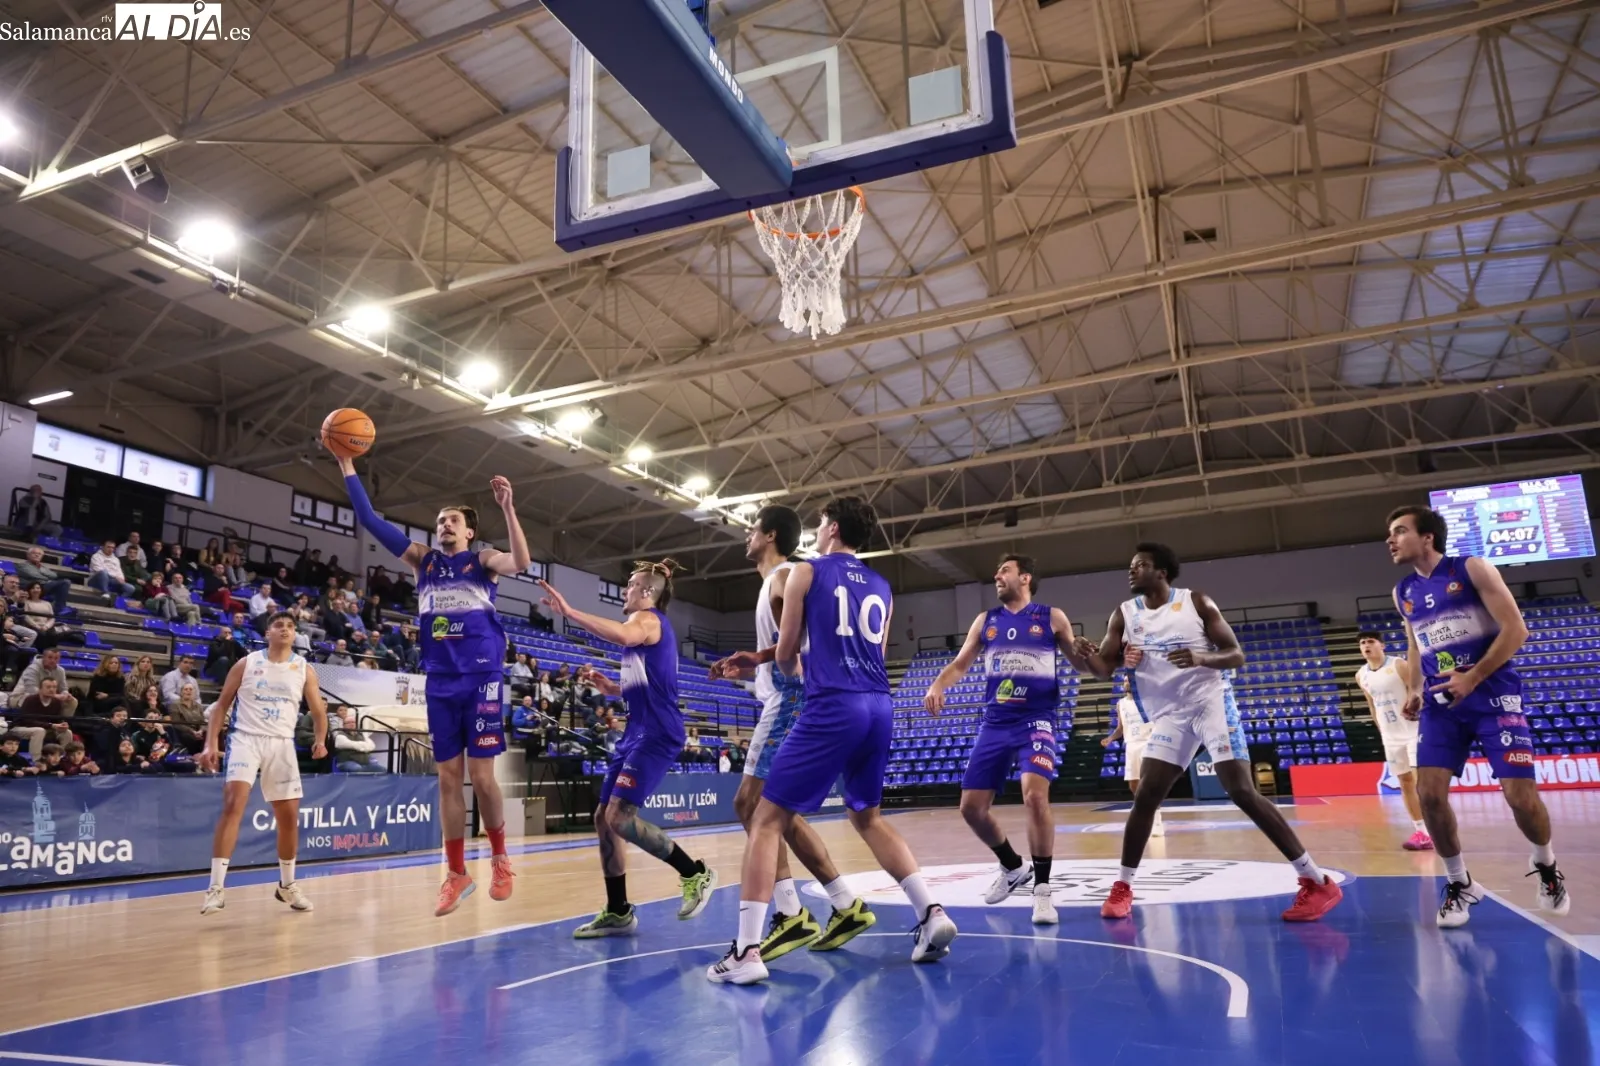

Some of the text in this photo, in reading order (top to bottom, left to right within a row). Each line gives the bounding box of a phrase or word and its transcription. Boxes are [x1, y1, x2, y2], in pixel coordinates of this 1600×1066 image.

[709, 46, 744, 104] MONDO
[1490, 527, 1535, 543] 04:07
[1495, 547, 1503, 556] 2
[846, 571, 867, 584] GIL
[1424, 593, 1435, 609] 5
[834, 585, 887, 645] 10
[1007, 627, 1017, 640] 0
[1429, 625, 1452, 637] XUNTA
[1440, 628, 1470, 642] GALICIA
[1384, 710, 1398, 723] 13
[644, 788, 717, 810] CASTILLA Y LEÓN
[252, 797, 431, 831] CTILLA Y LEÓN
[307, 831, 389, 852] NOS IMPULSA
